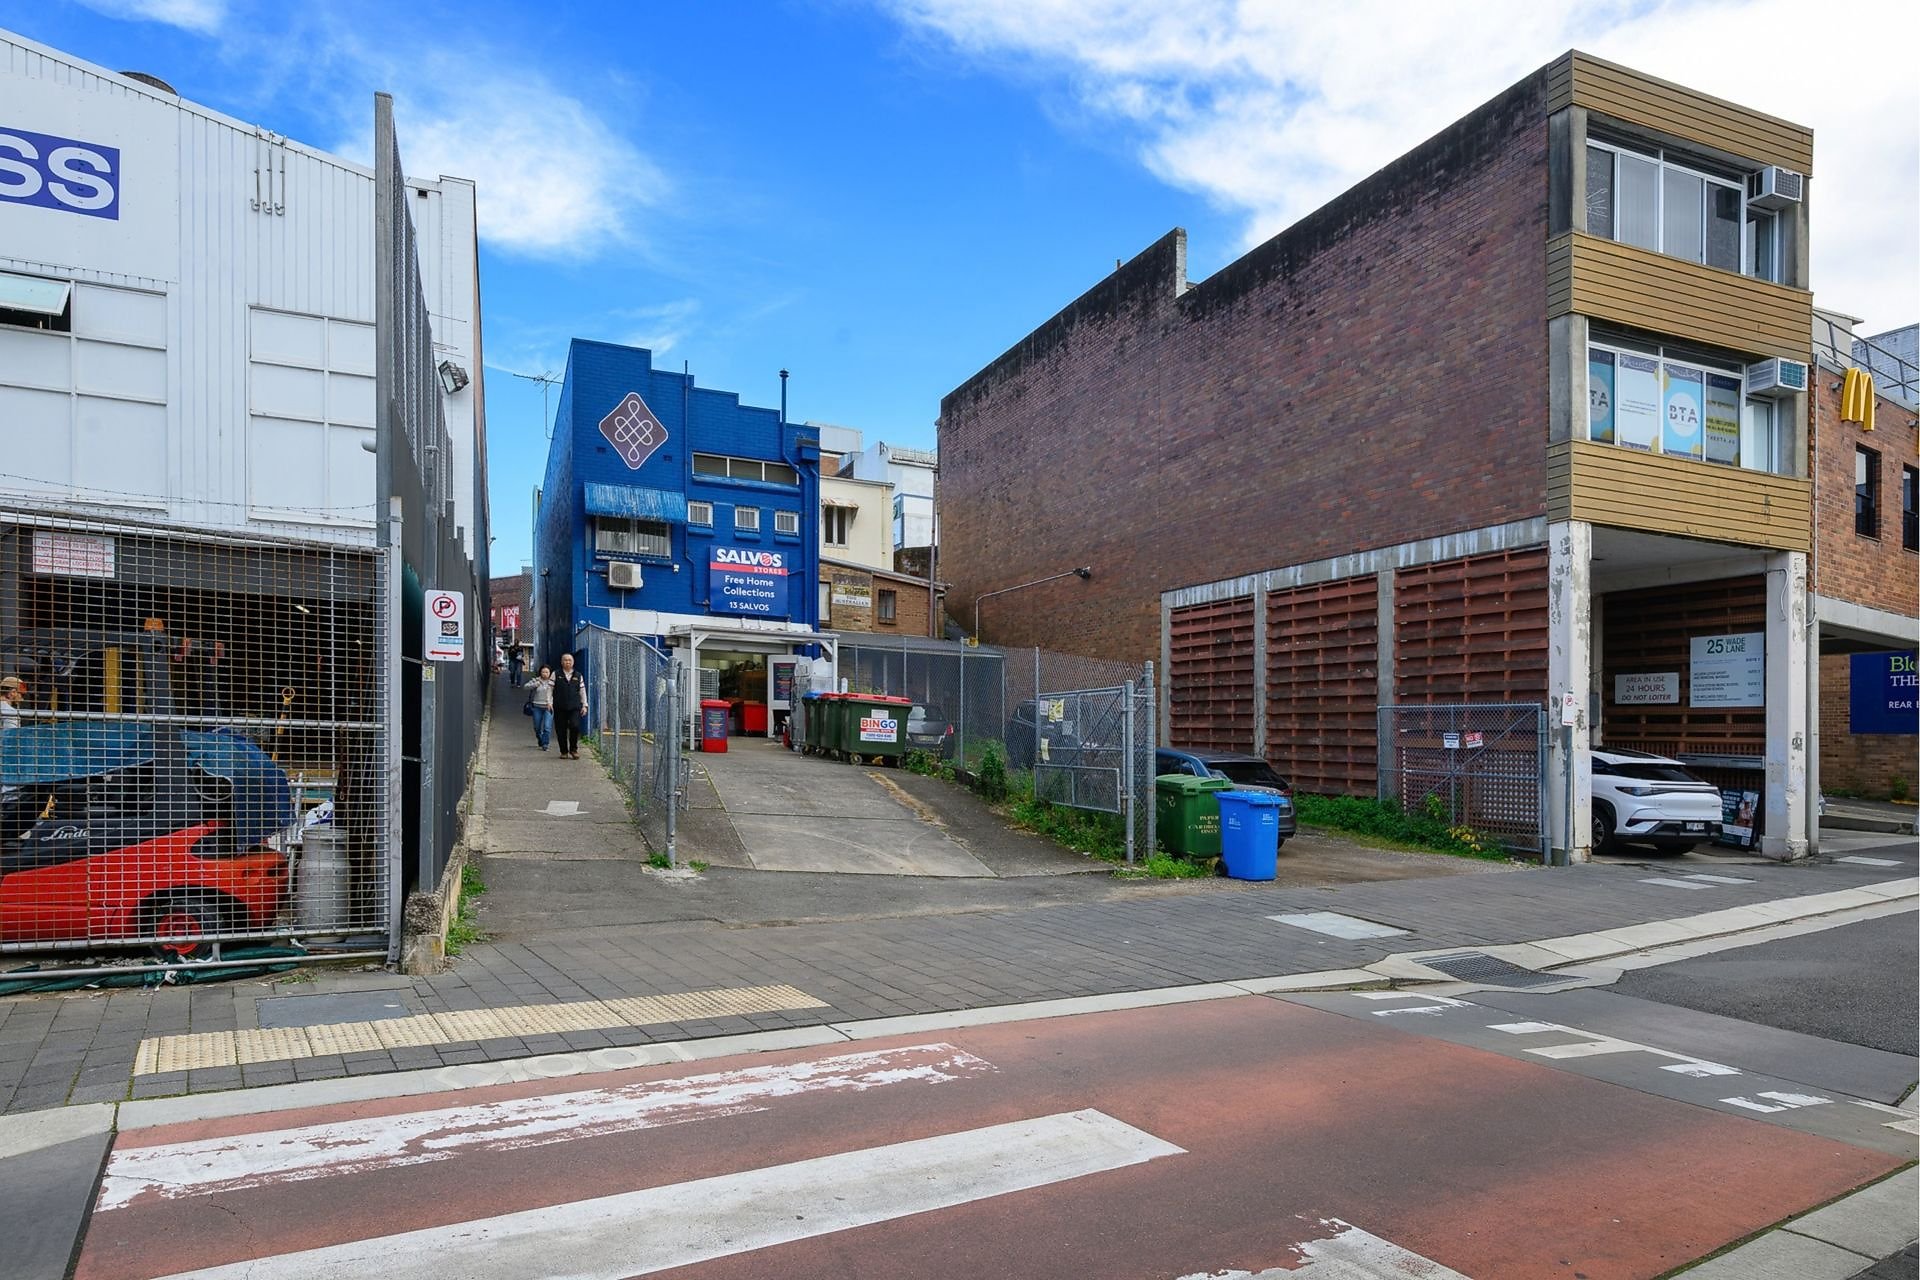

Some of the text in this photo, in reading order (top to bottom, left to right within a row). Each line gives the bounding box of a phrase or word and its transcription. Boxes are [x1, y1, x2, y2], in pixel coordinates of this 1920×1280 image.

[716, 548, 783, 568] SALVOS
[753, 566, 783, 576] STORES
[724, 574, 775, 587] Free Home
[723, 586, 776, 599] Collections
[729, 601, 770, 612] 13 SALVOS
[1707, 639, 1724, 654] 25
[1726, 637, 1746, 646] WADE
[1725, 644, 1746, 654] LANE
[1625, 683, 1666, 693] 24 HOURS
[1648, 693, 1672, 701] LOITER
[861, 719, 897, 729] BINGO
